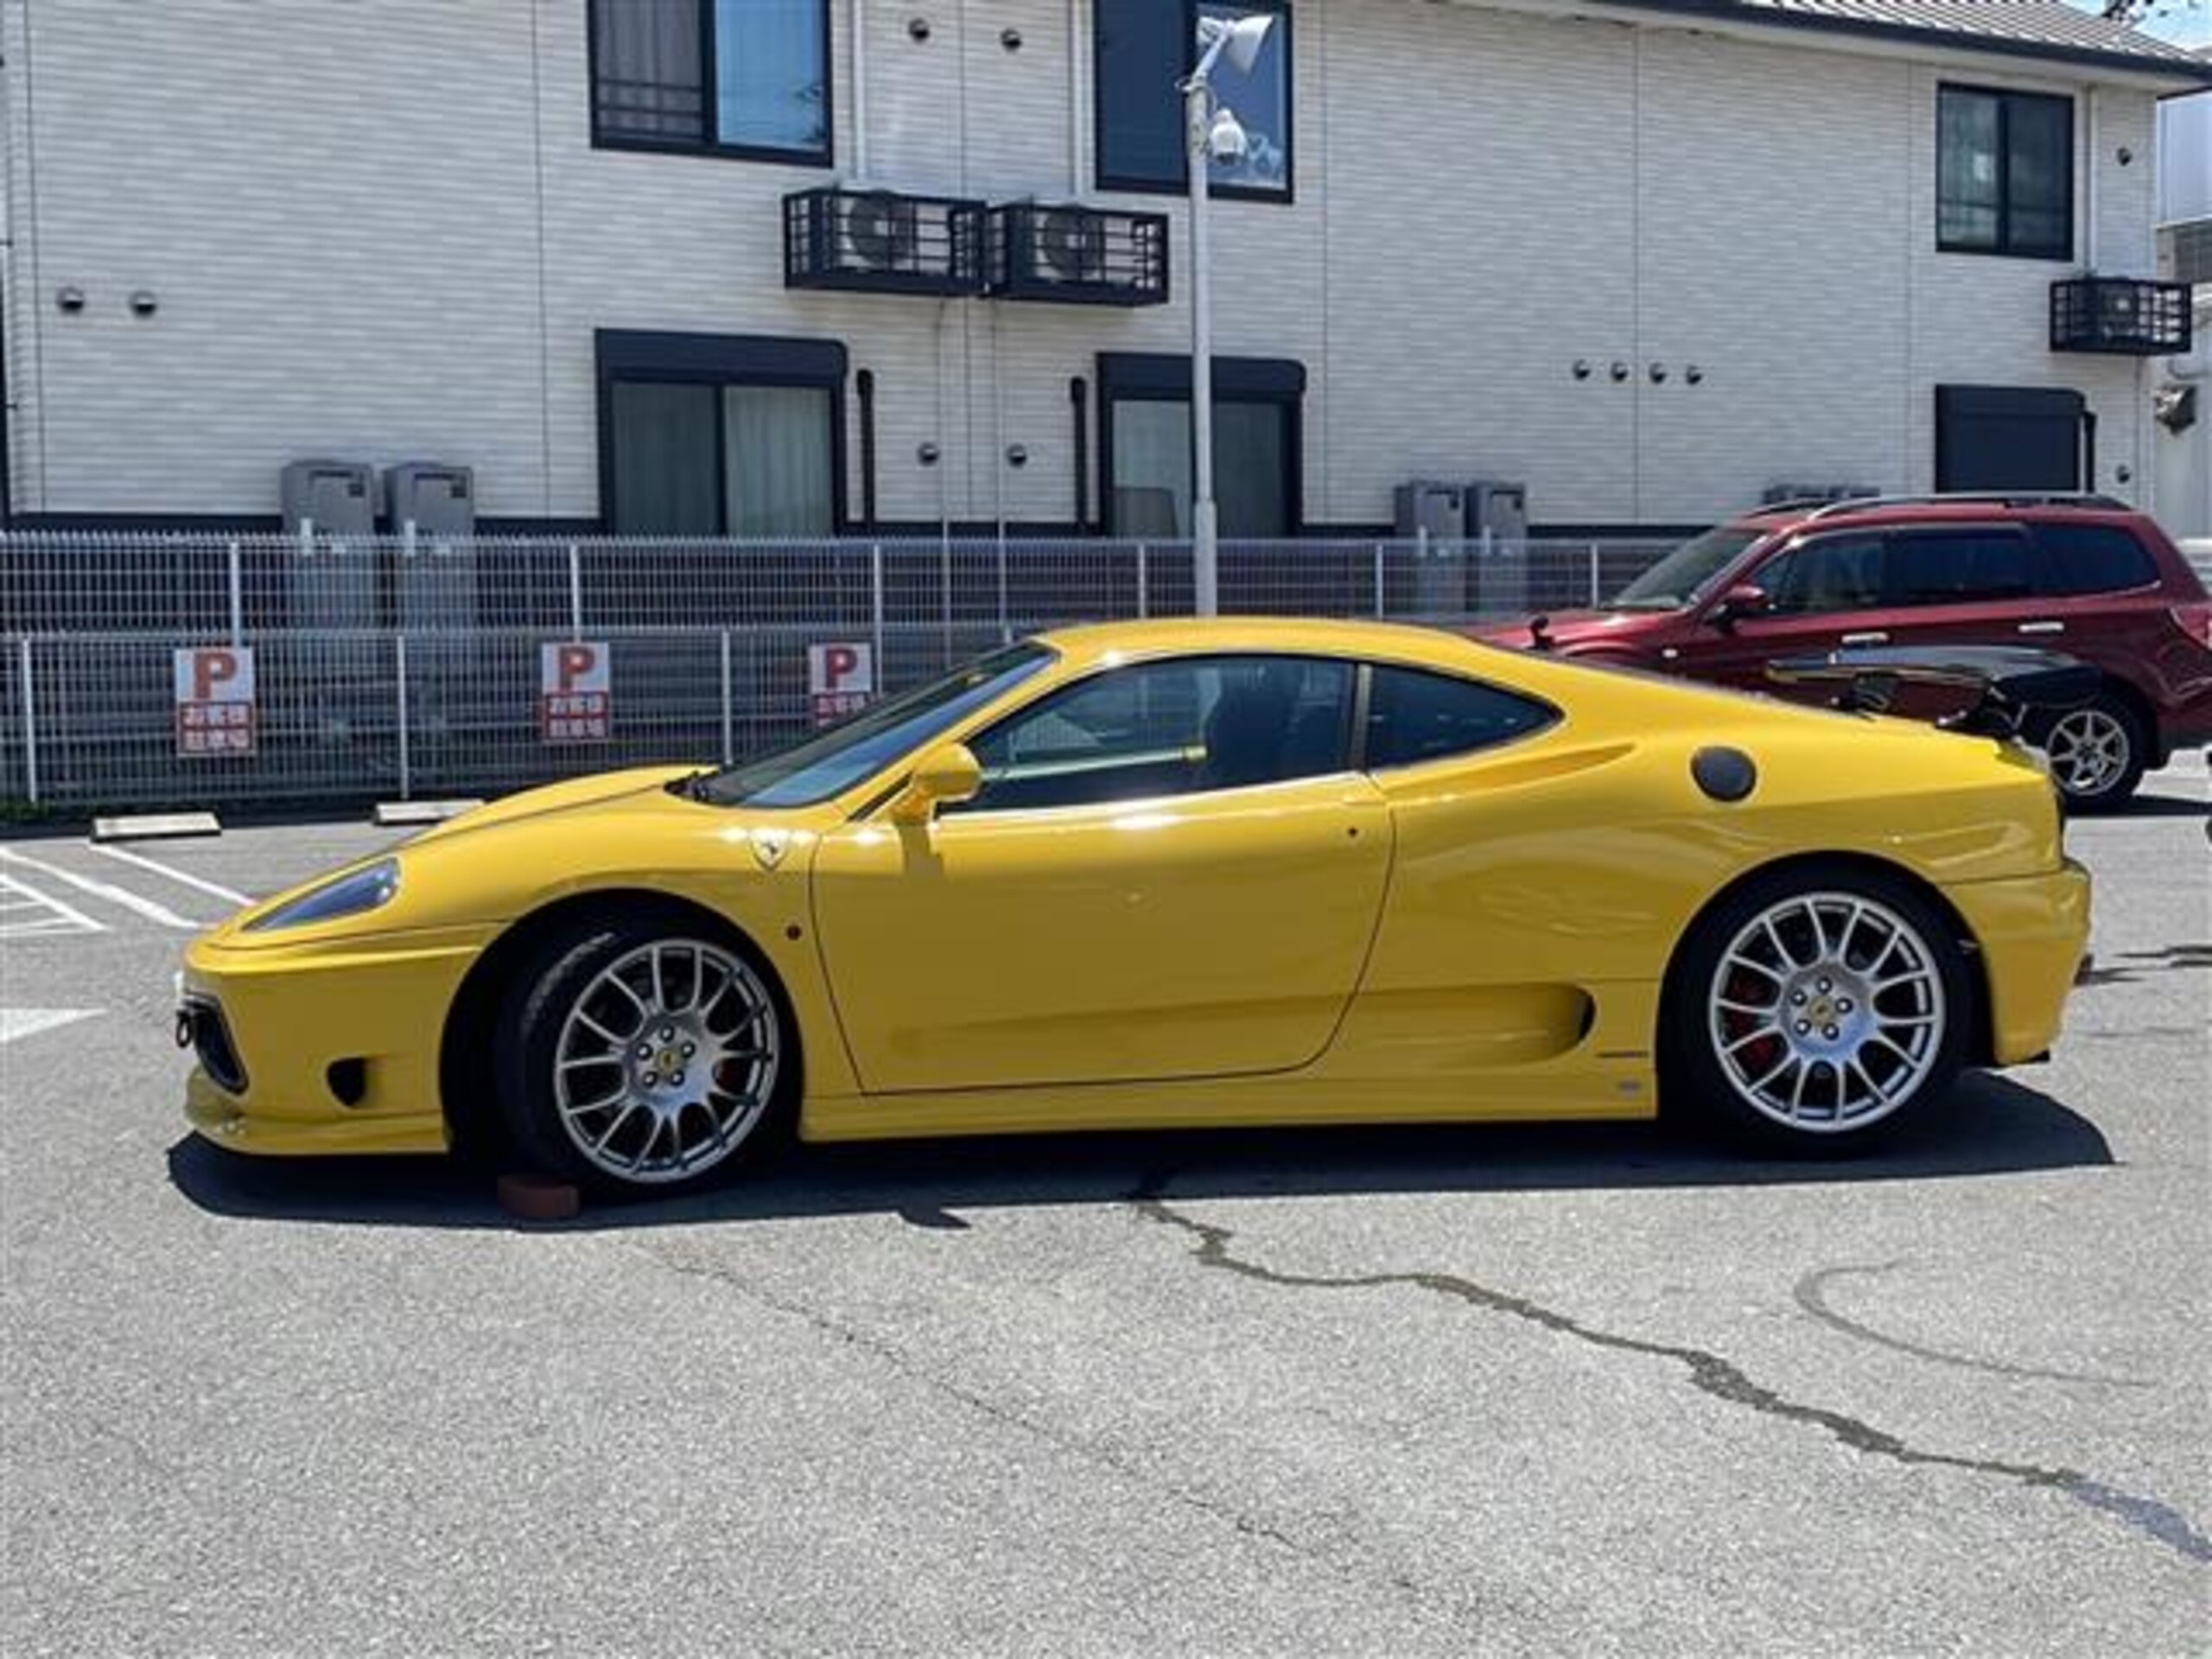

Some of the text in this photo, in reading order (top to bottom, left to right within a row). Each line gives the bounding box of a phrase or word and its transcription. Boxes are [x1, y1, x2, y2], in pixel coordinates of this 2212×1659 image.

[194, 652, 237, 698] P
[559, 647, 595, 690] P
[827, 649, 857, 690] P
